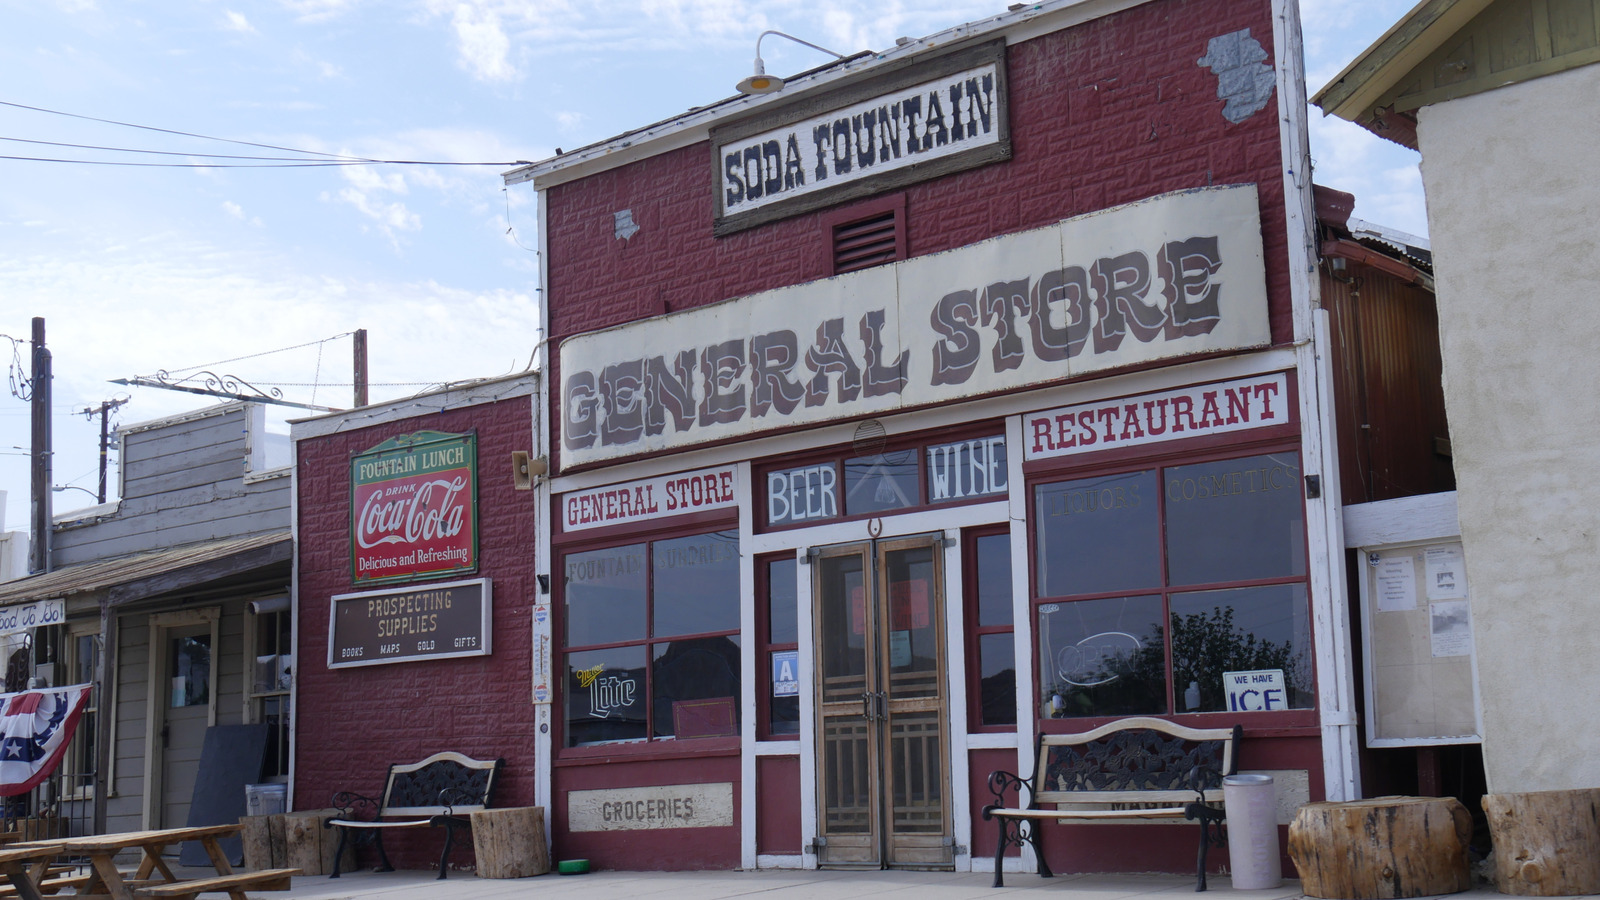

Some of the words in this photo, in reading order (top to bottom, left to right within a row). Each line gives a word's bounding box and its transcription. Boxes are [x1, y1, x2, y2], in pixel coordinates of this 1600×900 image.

[725, 132, 805, 207] SODA
[812, 72, 994, 182] FOUNTAIN
[562, 308, 911, 453] GENERAL
[930, 235, 1225, 386] STORE
[1031, 382, 1279, 453] RESTAURANT
[360, 455, 418, 481] FOUNTAIN
[422, 447, 465, 470] LUNCH
[385, 483, 417, 497] DRINK
[767, 465, 838, 523] BEER
[926, 436, 1008, 500] WINE
[1050, 484, 1142, 517] LIQUORS
[1168, 464, 1298, 502] COSMETICS
[567, 484, 659, 526] GENERAL
[665, 471, 734, 511] STORE
[359, 555, 397, 571] Delicious
[399, 550, 415, 565] and
[417, 545, 468, 563] Refreshing
[568, 553, 642, 583] FOUNTAIN
[22, 604, 37, 626] To
[368, 591, 452, 618] PROSPECTING
[378, 614, 438, 638] SUPPLIES
[342, 646, 364, 658] BOOKS
[380, 643, 400, 655] MAPS
[417, 640, 435, 651] GOLD
[454, 636, 476, 648] GIFTS
[779, 660, 794, 682] A
[1234, 675, 1248, 684] WE
[1252, 674, 1273, 683] HAVE
[589, 676, 636, 718] Lite
[602, 797, 694, 822] GROCERIES
